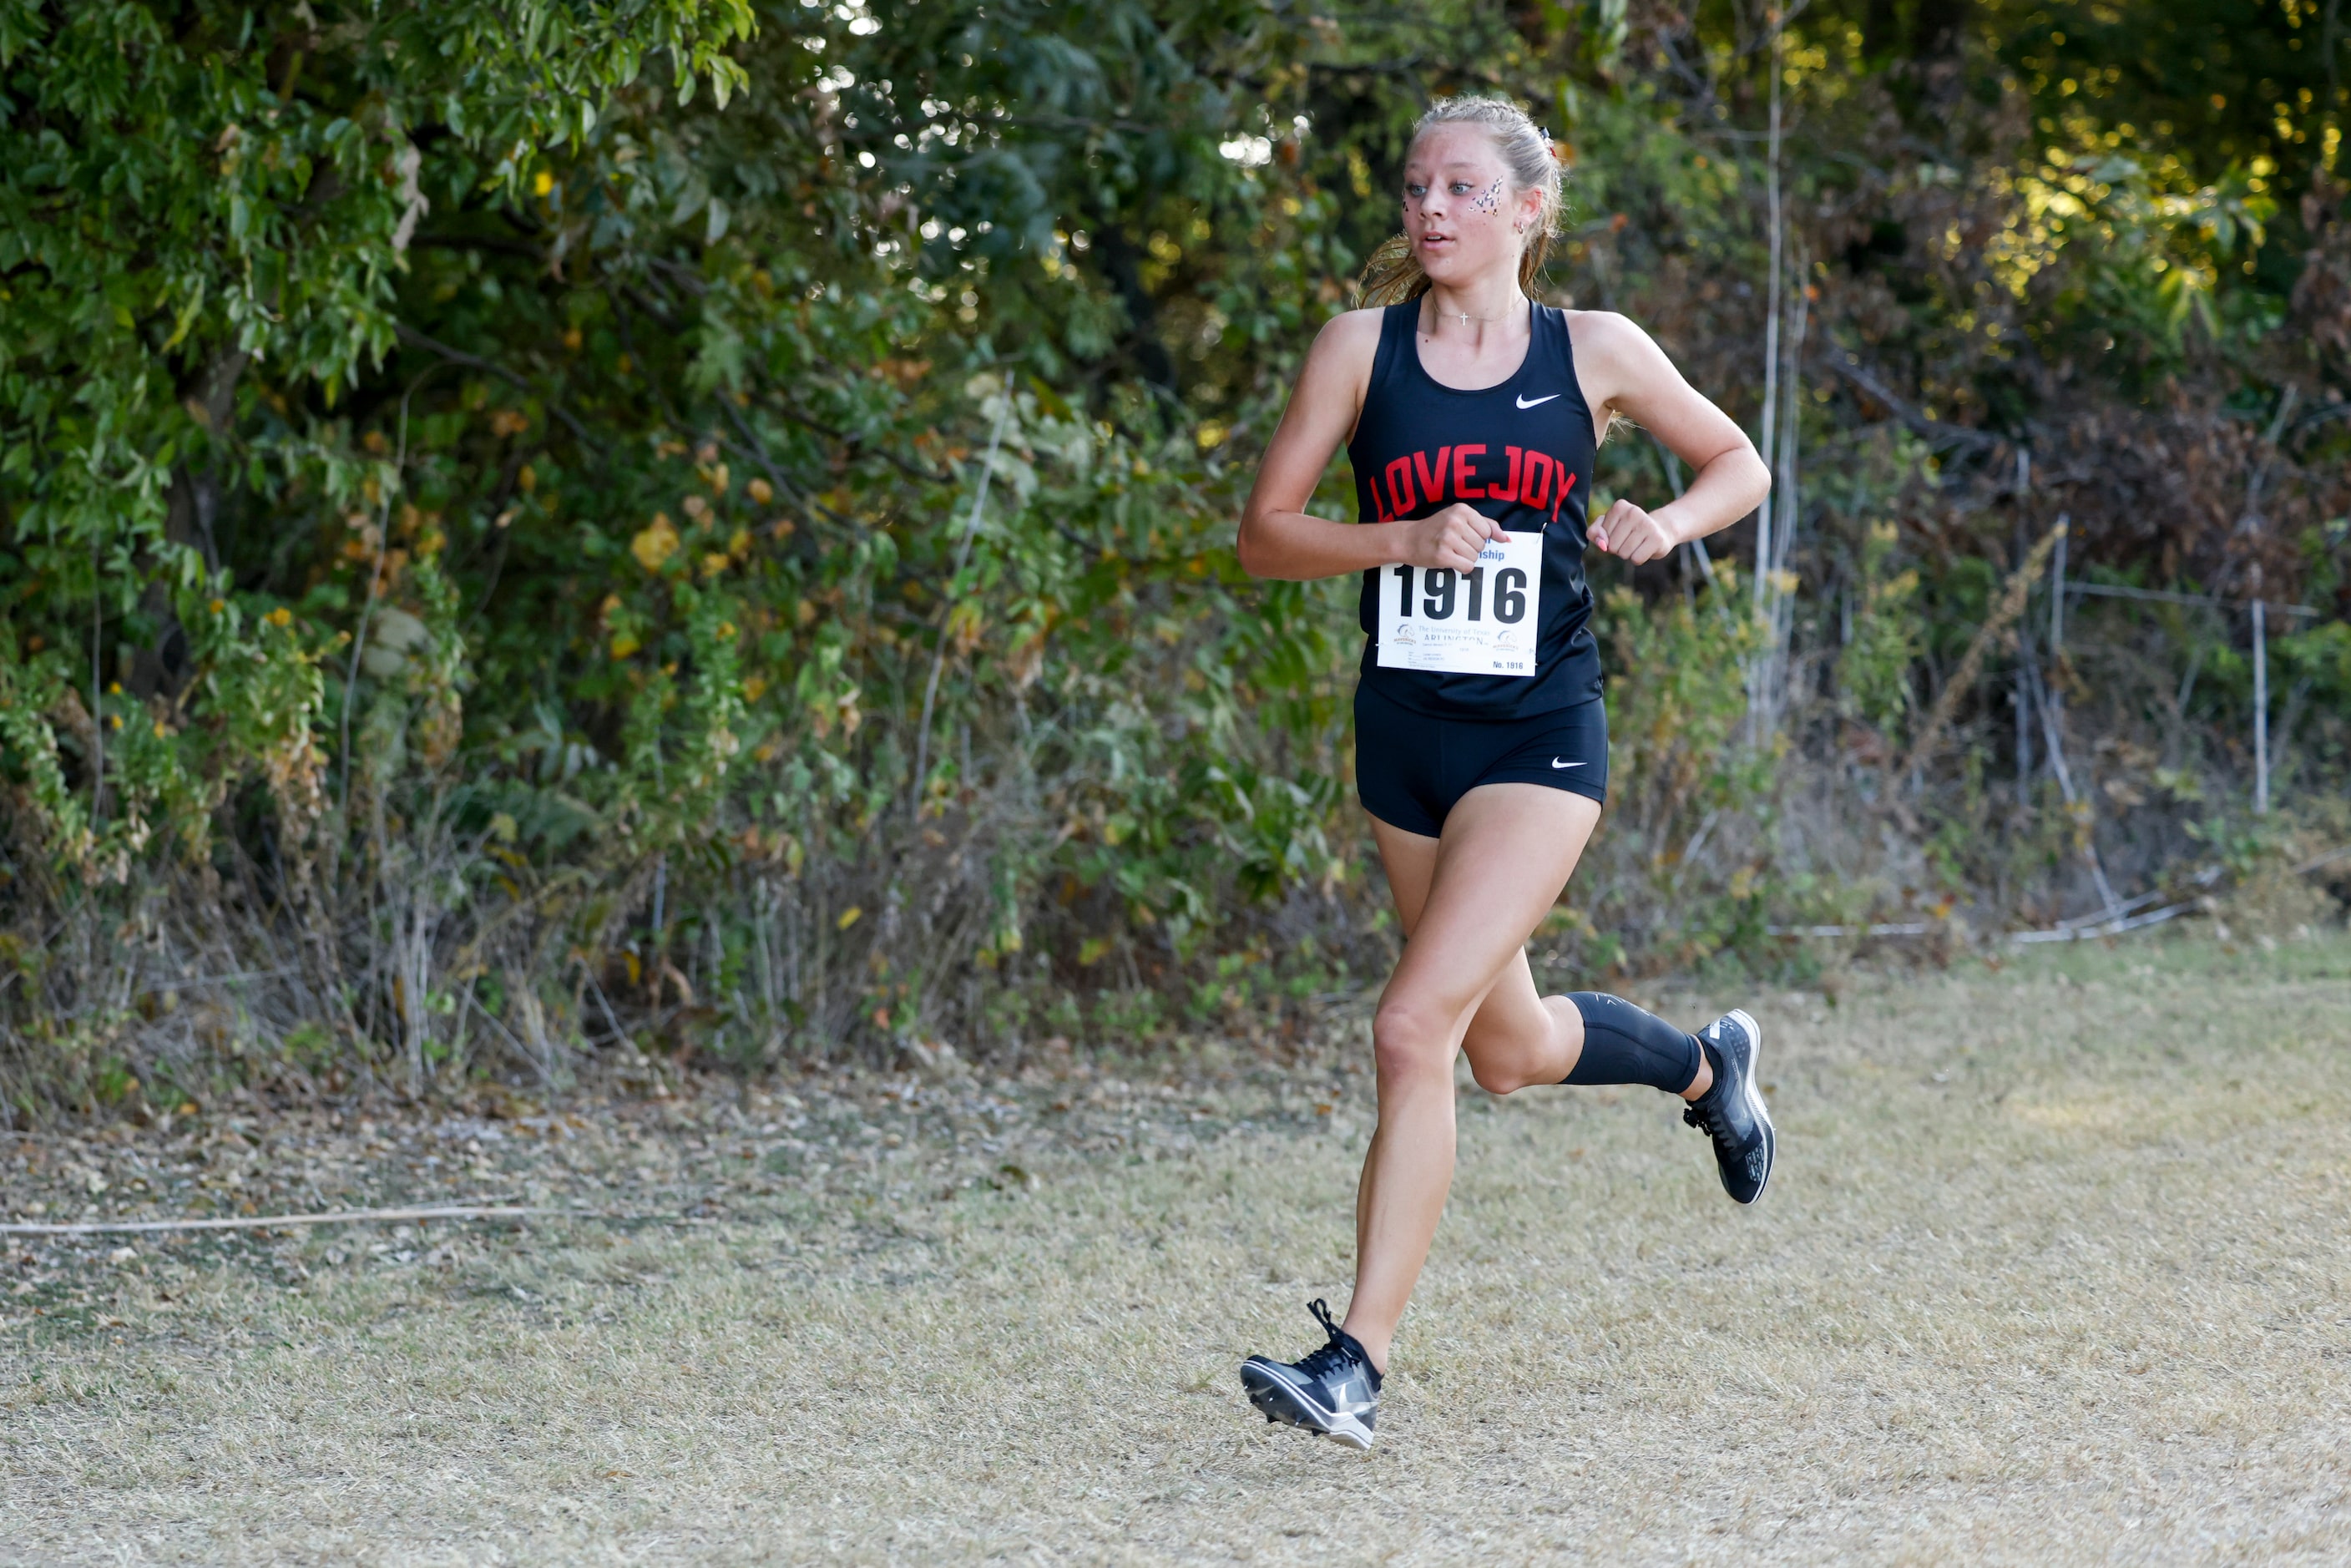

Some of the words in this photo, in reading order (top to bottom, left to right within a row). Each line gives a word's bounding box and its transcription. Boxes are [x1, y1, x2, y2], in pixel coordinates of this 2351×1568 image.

[1370, 444, 1576, 524] LOVEJOY
[1393, 564, 1527, 625] 1916
[1418, 625, 1429, 633] The
[1431, 625, 1461, 635] University
[1493, 660, 1504, 669] No.
[1506, 661, 1524, 670] 1916
